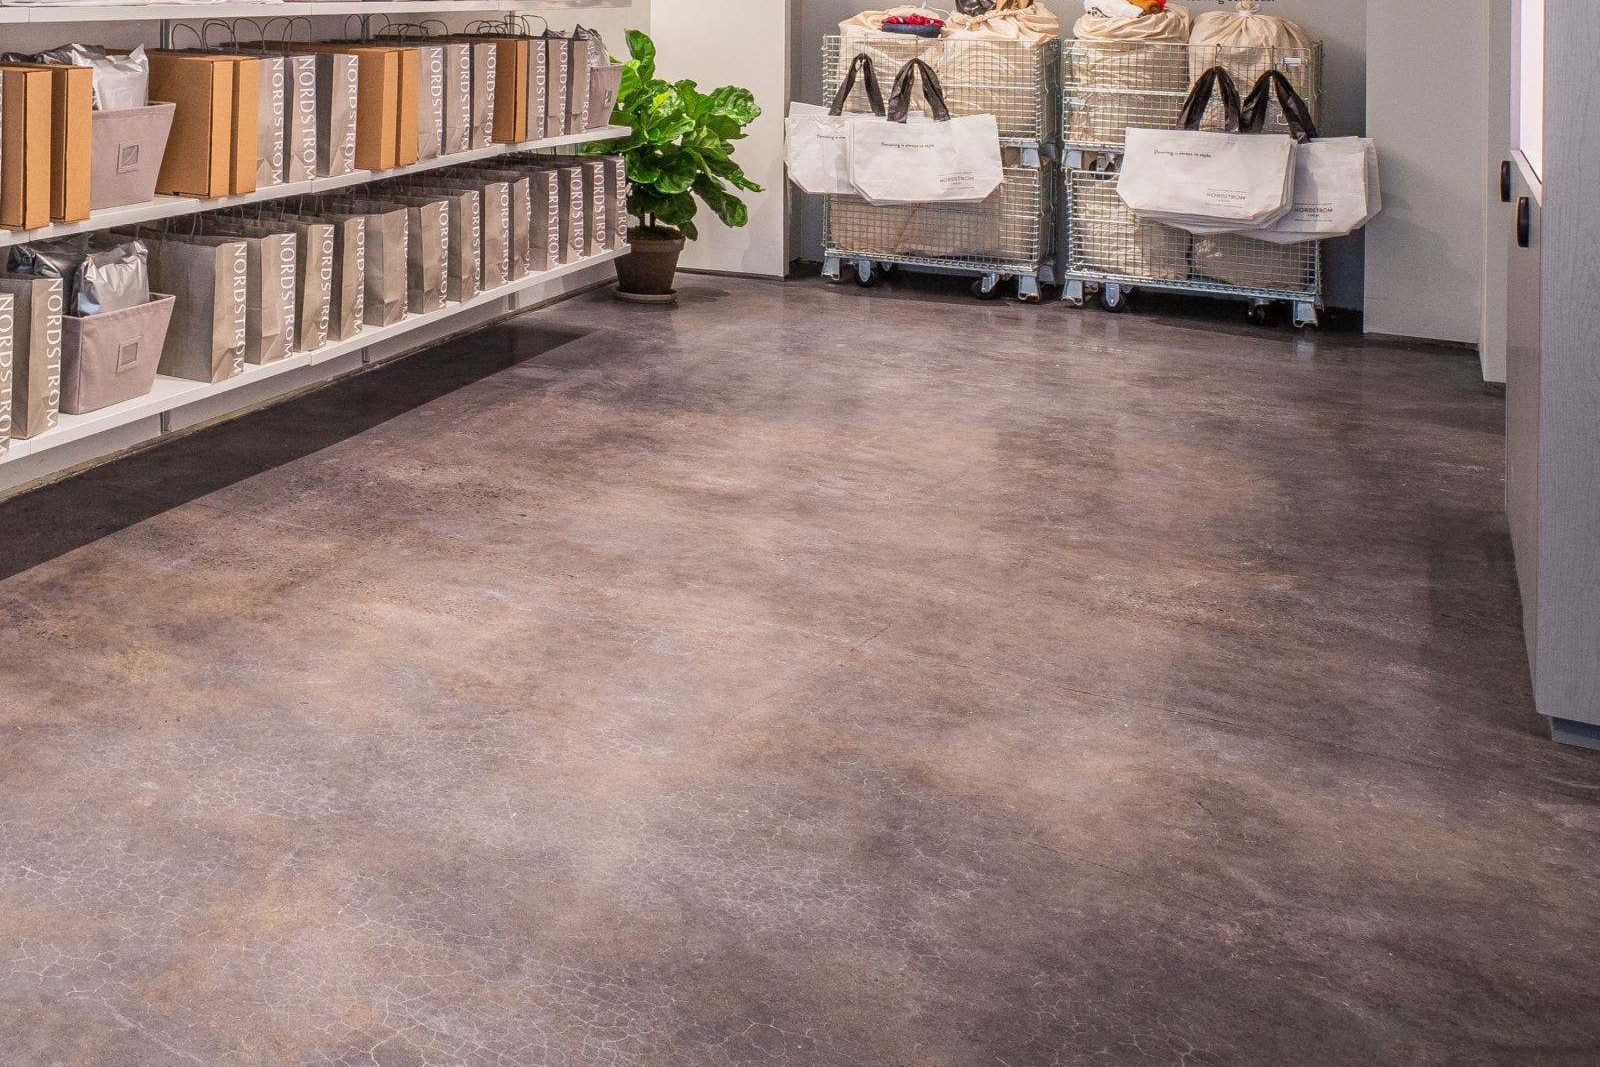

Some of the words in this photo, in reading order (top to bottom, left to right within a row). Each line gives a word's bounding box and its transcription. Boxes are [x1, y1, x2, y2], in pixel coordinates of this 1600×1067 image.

[272, 58, 285, 185] NORDSTROM
[299, 57, 316, 181] NORDSTROM
[344, 54, 359, 173] NORDSTROM
[483, 44, 497, 146] NORDSTROM
[560, 40, 569, 136] NORDSTROM
[439, 200, 449, 309] NORDSTROM
[472, 190, 480, 295] NORDSTROM
[501, 181, 509, 285] NORDSTROM
[548, 170, 560, 267] NORDSTROM
[570, 166, 584, 260] NORDSTROM
[593, 163, 607, 254] NORDSTROM
[616, 159, 628, 247] NORDSTROM
[233, 243, 247, 374] NORDSTROM
[280, 233, 297, 358] NORDSTROM
[318, 226, 335, 347] NORDSTROM
[353, 216, 365, 334] NORDSTROM
[47, 278, 64, 429] NORDSTROM
